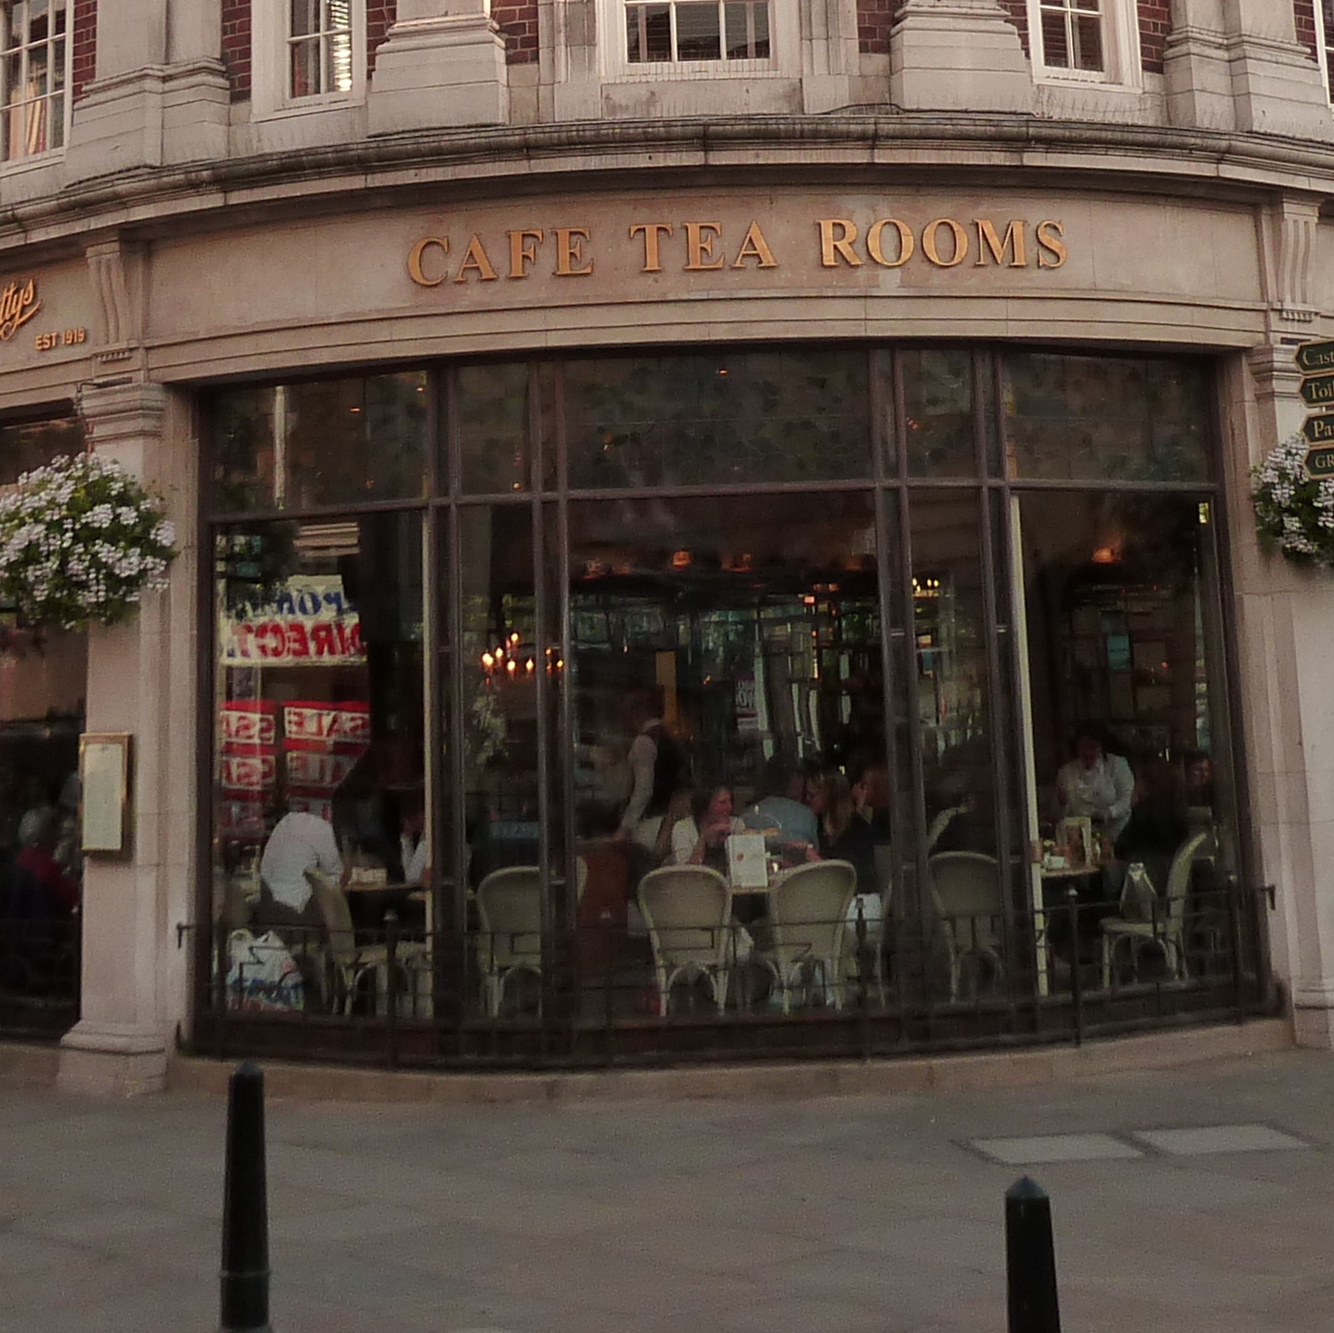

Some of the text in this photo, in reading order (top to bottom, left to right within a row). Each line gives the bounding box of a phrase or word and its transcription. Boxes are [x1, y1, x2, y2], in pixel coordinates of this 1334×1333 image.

[406, 218, 1068, 287] CAFE TEA ROOMS
[35, 328, 85, 350] EST 1919
